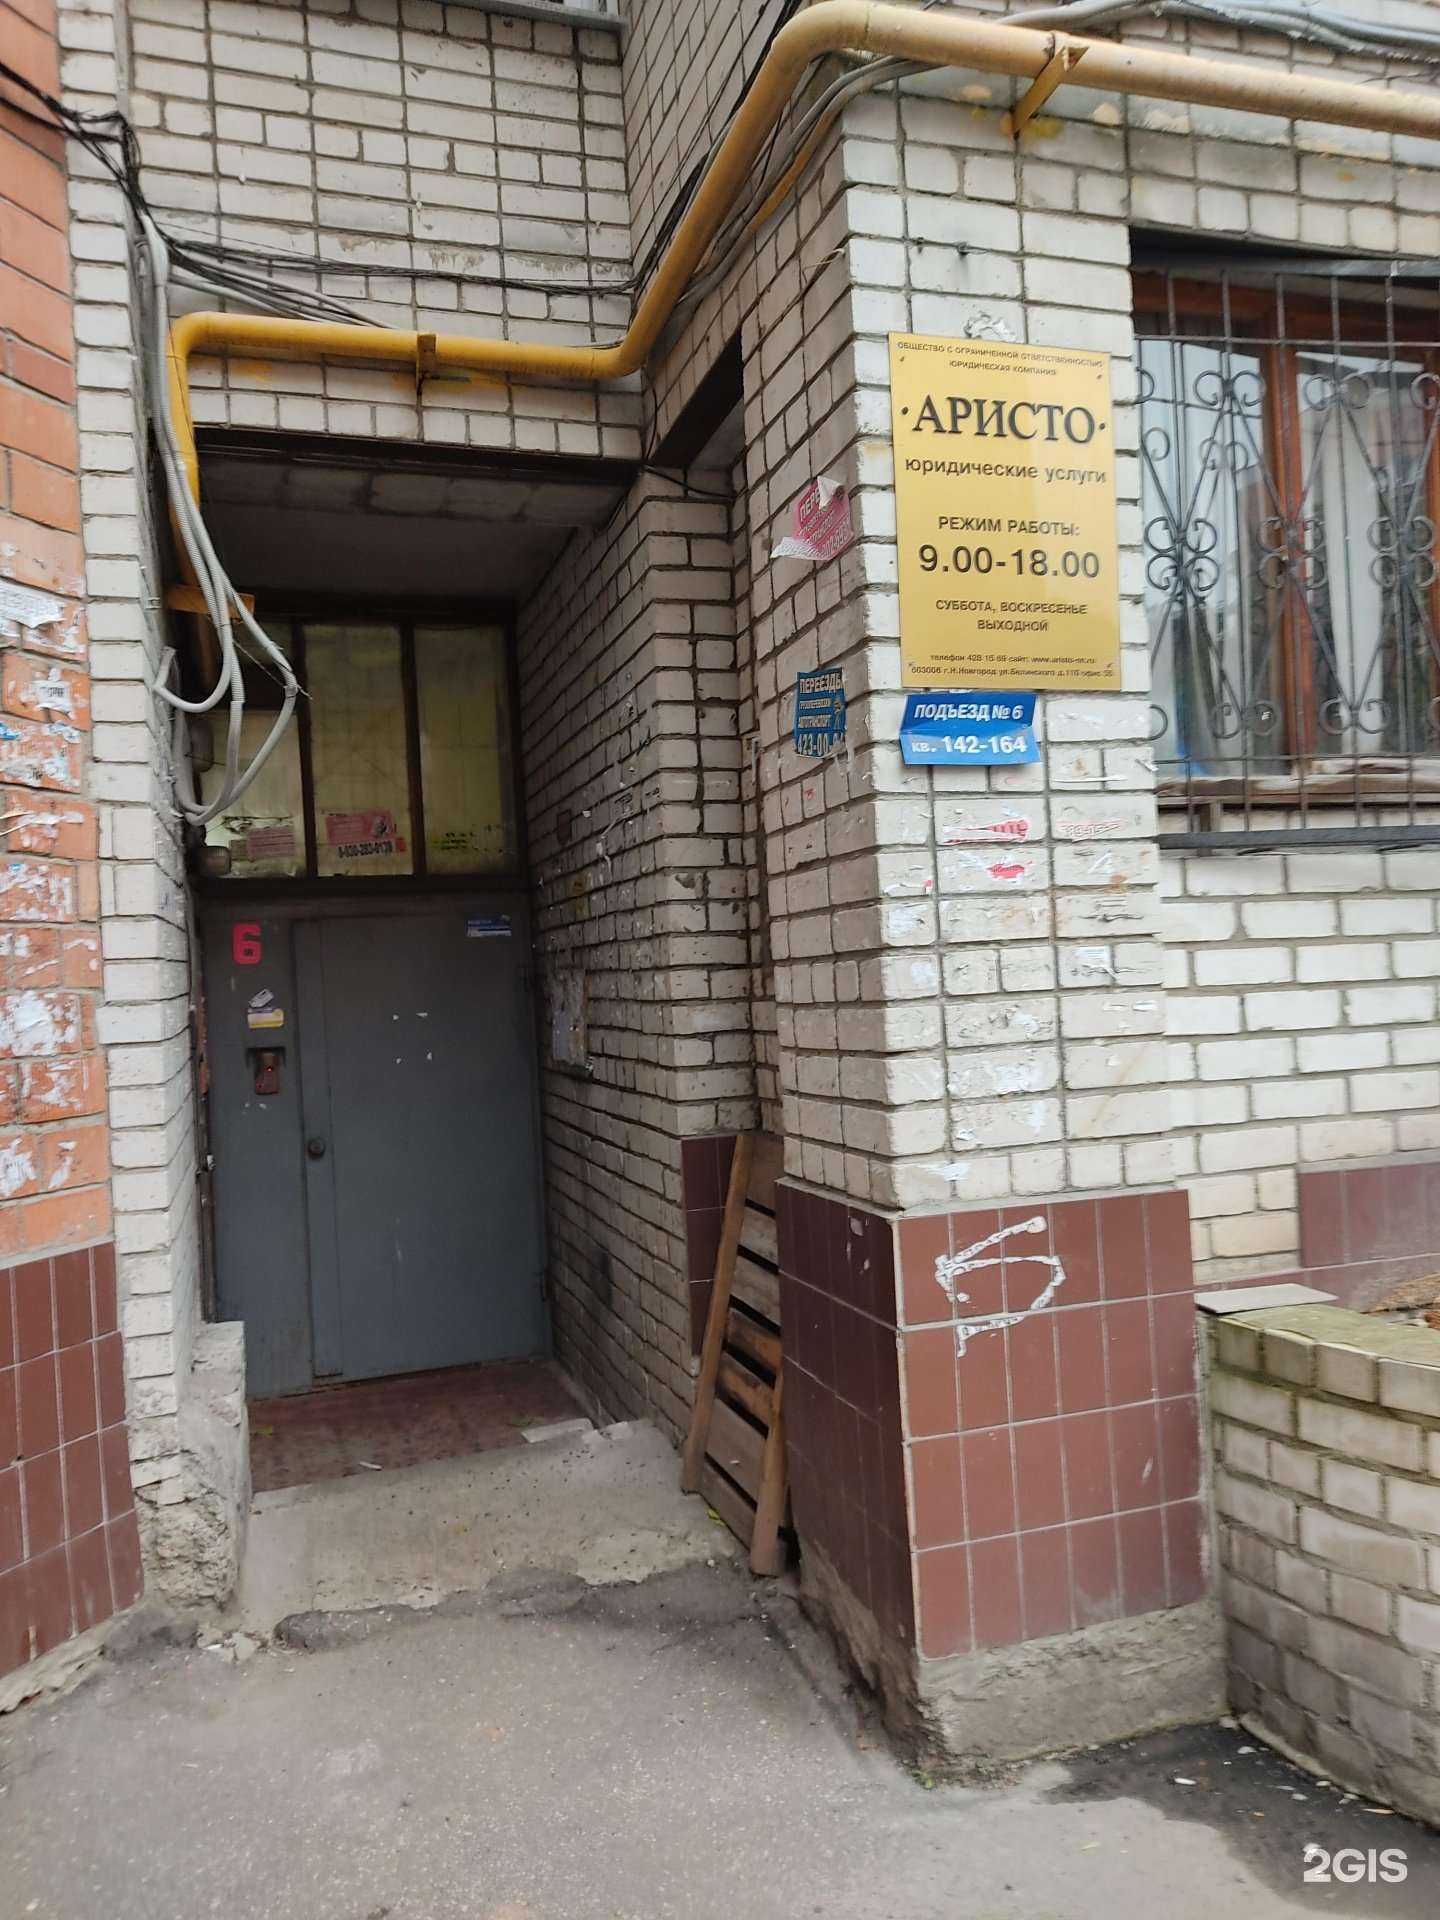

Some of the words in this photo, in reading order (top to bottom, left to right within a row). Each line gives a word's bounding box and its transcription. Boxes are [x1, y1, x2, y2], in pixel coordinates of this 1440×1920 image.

[897, 341, 946, 353] ОБЩЕСТВО
[946, 346, 953, 354] С
[955, 346, 1019, 359] ОГРАНИЧЕННОЙ
[949, 360, 1011, 372] ЮРИДИЧЕСКАЯ
[1012, 365, 1057, 376] КОМПАНИЯ
[912, 394, 1096, 444] АРИСТО
[905, 457, 1038, 478] юридические
[1044, 465, 1107, 484] услуги
[938, 515, 1001, 533] РЕЖИМ
[1007, 519, 1081, 536] РАБОТЫ:
[918, 543, 1100, 578] 9.00-18.00
[935, 599, 997, 614] СУББОТА,
[1000, 601, 1088, 615] ВОСКРЕСЕНЬЕ
[976, 618, 1049, 633] ВЫХОДНОЙ
[913, 703, 990, 722] ПОДЪЕЗД
[911, 741, 938, 753] кв.
[941, 735, 1028, 754] 142-164
[231, 922, 263, 966] 6
